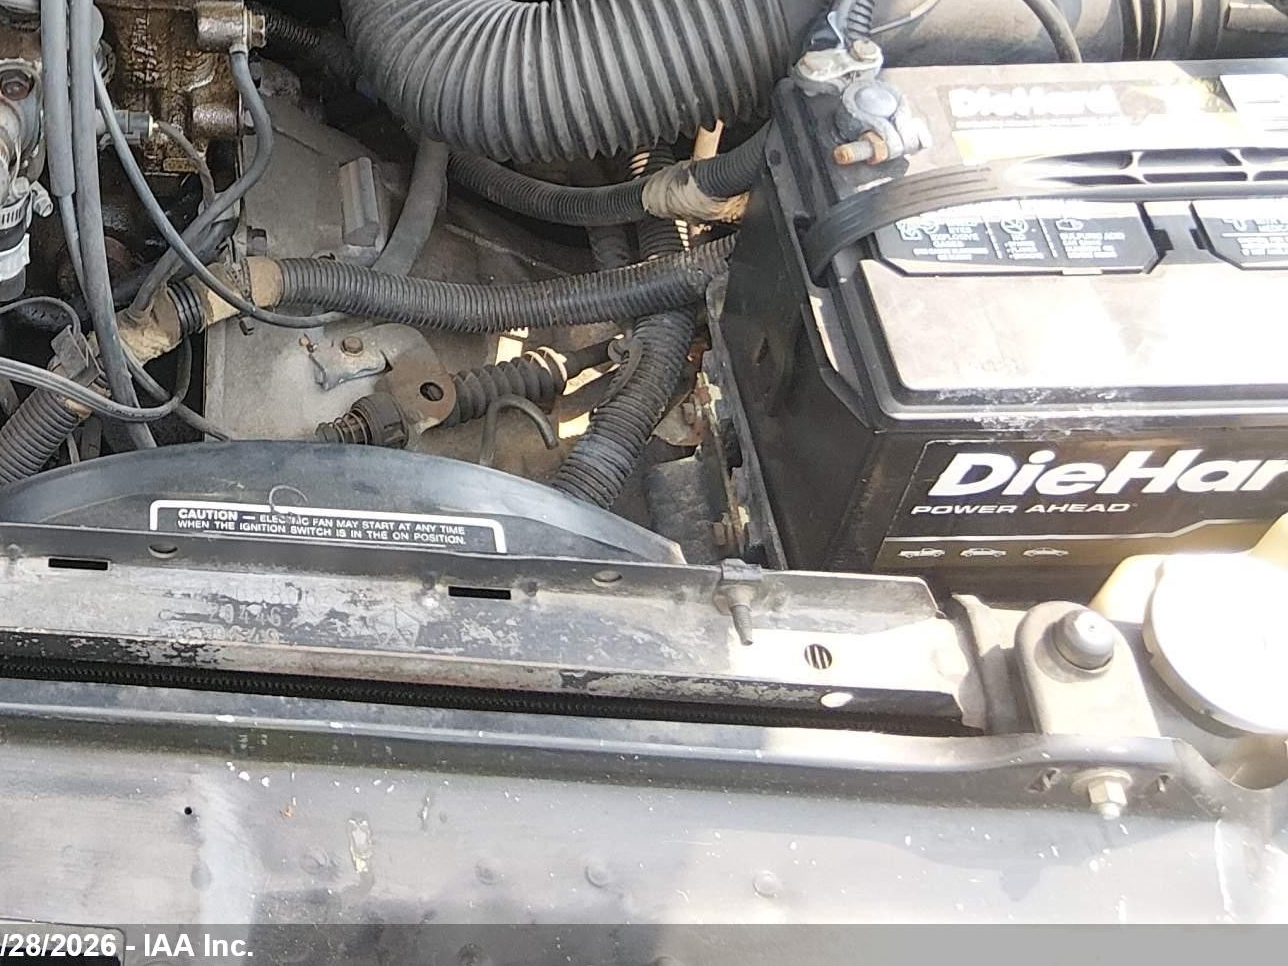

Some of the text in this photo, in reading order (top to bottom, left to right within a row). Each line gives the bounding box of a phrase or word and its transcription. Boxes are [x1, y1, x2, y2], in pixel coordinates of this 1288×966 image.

[927, 449, 1288, 496] DieHar
[178, 508, 238, 521] CAUTION
[312, 518, 333, 527] FAN
[336, 519, 359, 528] MAY
[362, 521, 395, 530] START
[399, 523, 412, 531] AT
[415, 523, 437, 533] ANY
[440, 525, 465, 535] TIME
[911, 503, 1134, 515] POWER AHEAD
[178, 520, 467, 545] WHEN THE IGNITION SWITCH IS IN THE ON POSITION.
